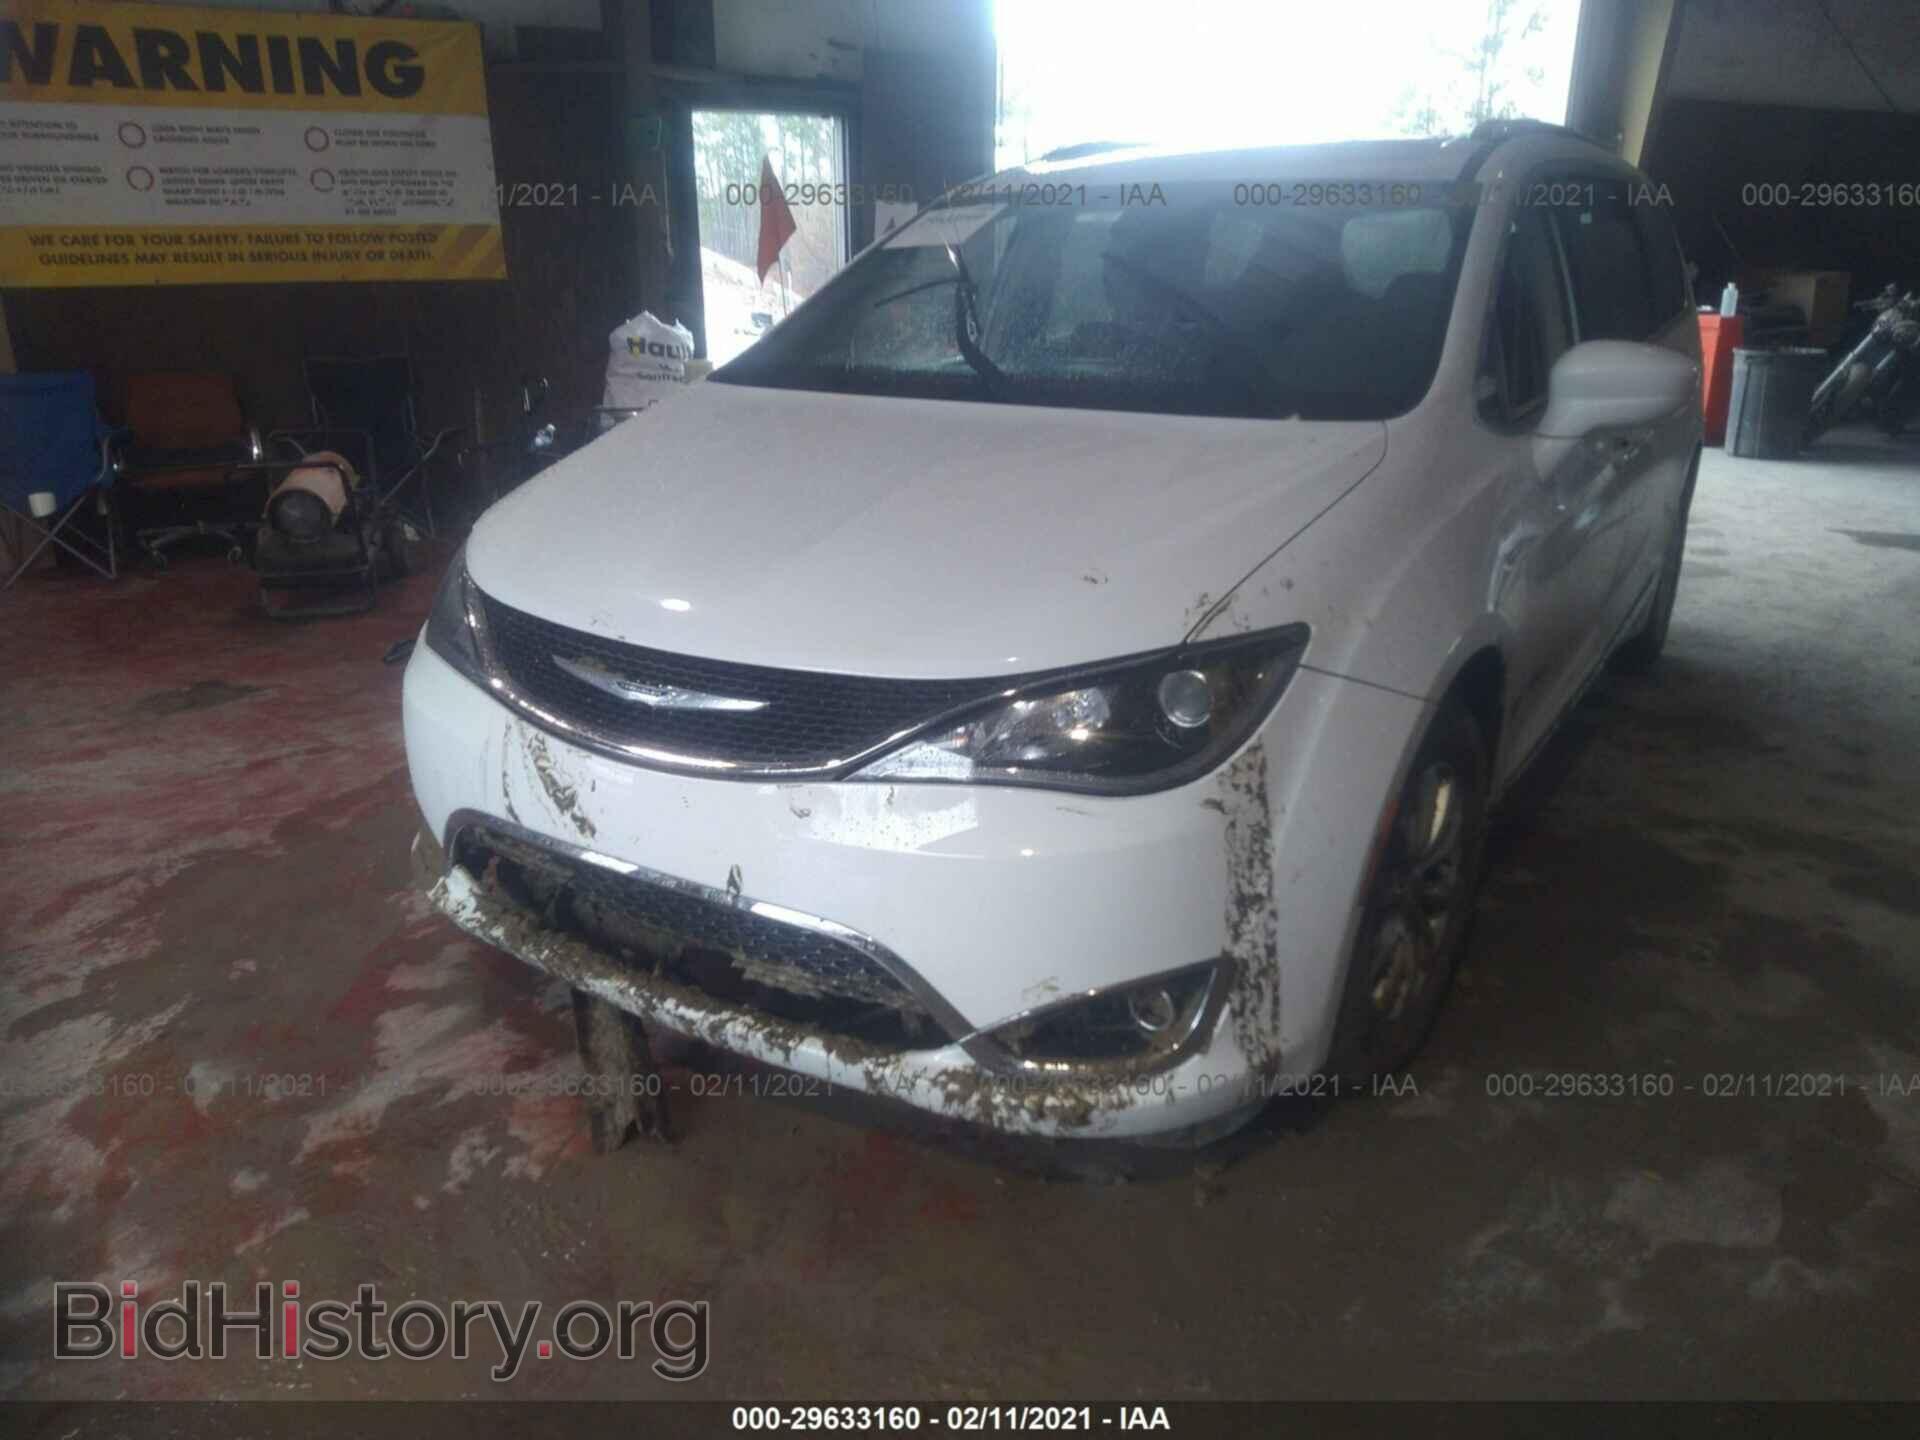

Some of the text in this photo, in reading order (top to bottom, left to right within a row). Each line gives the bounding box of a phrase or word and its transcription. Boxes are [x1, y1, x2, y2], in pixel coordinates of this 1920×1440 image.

[0, 20, 425, 99] WARNING
[59, 232, 99, 247] CARE
[104, 232, 135, 247] FOR
[141, 232, 184, 247] YOUR
[305, 232, 324, 245] TO
[327, 232, 385, 245] FOLLOW
[38, 252, 130, 267] GUIDELINES
[173, 252, 223, 265] RESULT
[312, 251, 361, 264] INJURY
[365, 251, 385, 263] OR
